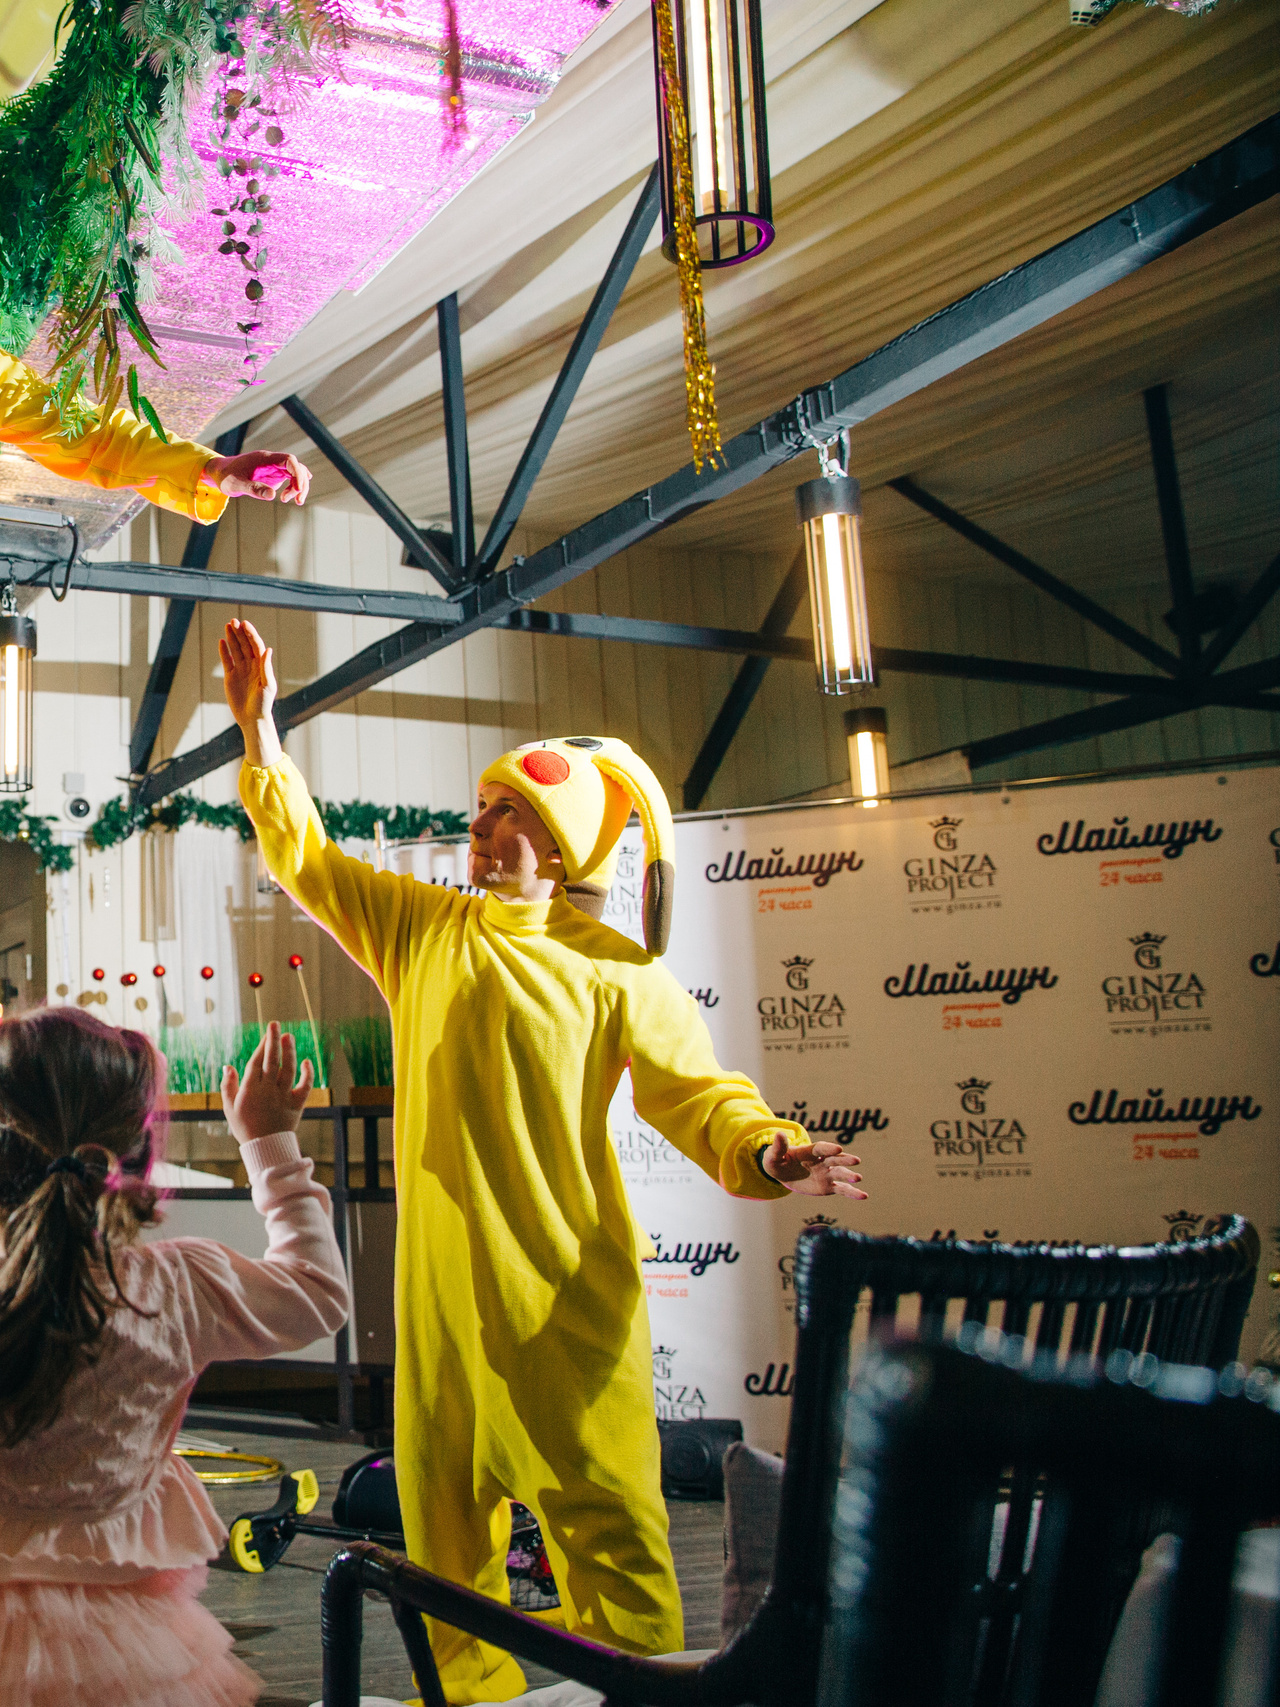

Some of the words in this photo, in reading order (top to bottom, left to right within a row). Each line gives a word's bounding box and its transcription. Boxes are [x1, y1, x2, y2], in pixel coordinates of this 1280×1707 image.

[1037, 816, 1223, 859] Маймун
[705, 847, 864, 887] Маймун
[904, 853, 997, 877] GINZA
[907, 872, 997, 900] PROJECT
[1124, 872, 1164, 885] часа
[779, 899, 812, 911] часа
[884, 961, 1058, 1004] Маймун
[1102, 973, 1205, 997] GINZA
[757, 993, 847, 1016] GINZA
[1106, 993, 1204, 1021] PROJECT
[760, 1012, 847, 1039] PROJECT
[965, 1017, 1002, 1029] часа
[1068, 1088, 1262, 1135] Маймун
[929, 1118, 1026, 1140] GINZA
[934, 1138, 1026, 1165] PROJECT
[655, 1384, 706, 1403] NZA
